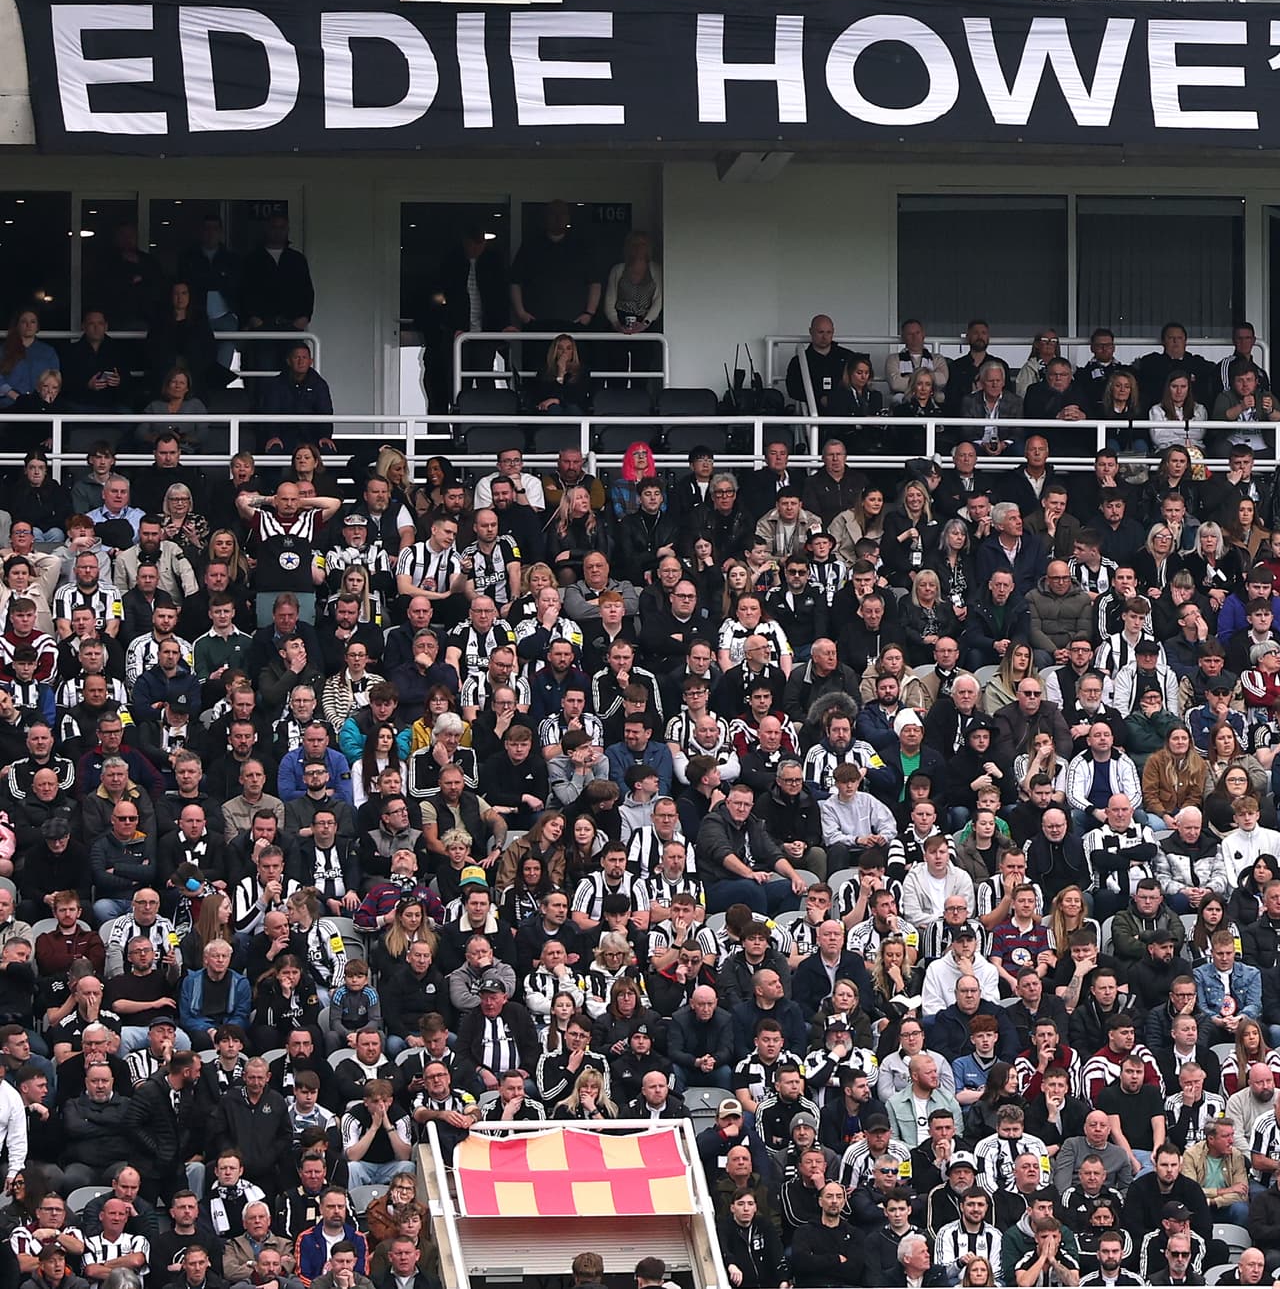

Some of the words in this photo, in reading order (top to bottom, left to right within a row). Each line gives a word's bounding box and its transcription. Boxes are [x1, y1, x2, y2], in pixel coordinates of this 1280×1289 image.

[51, 5, 624, 135] EDDIE
[597, 207, 625, 222] 106
[324, 867, 344, 879] sela
